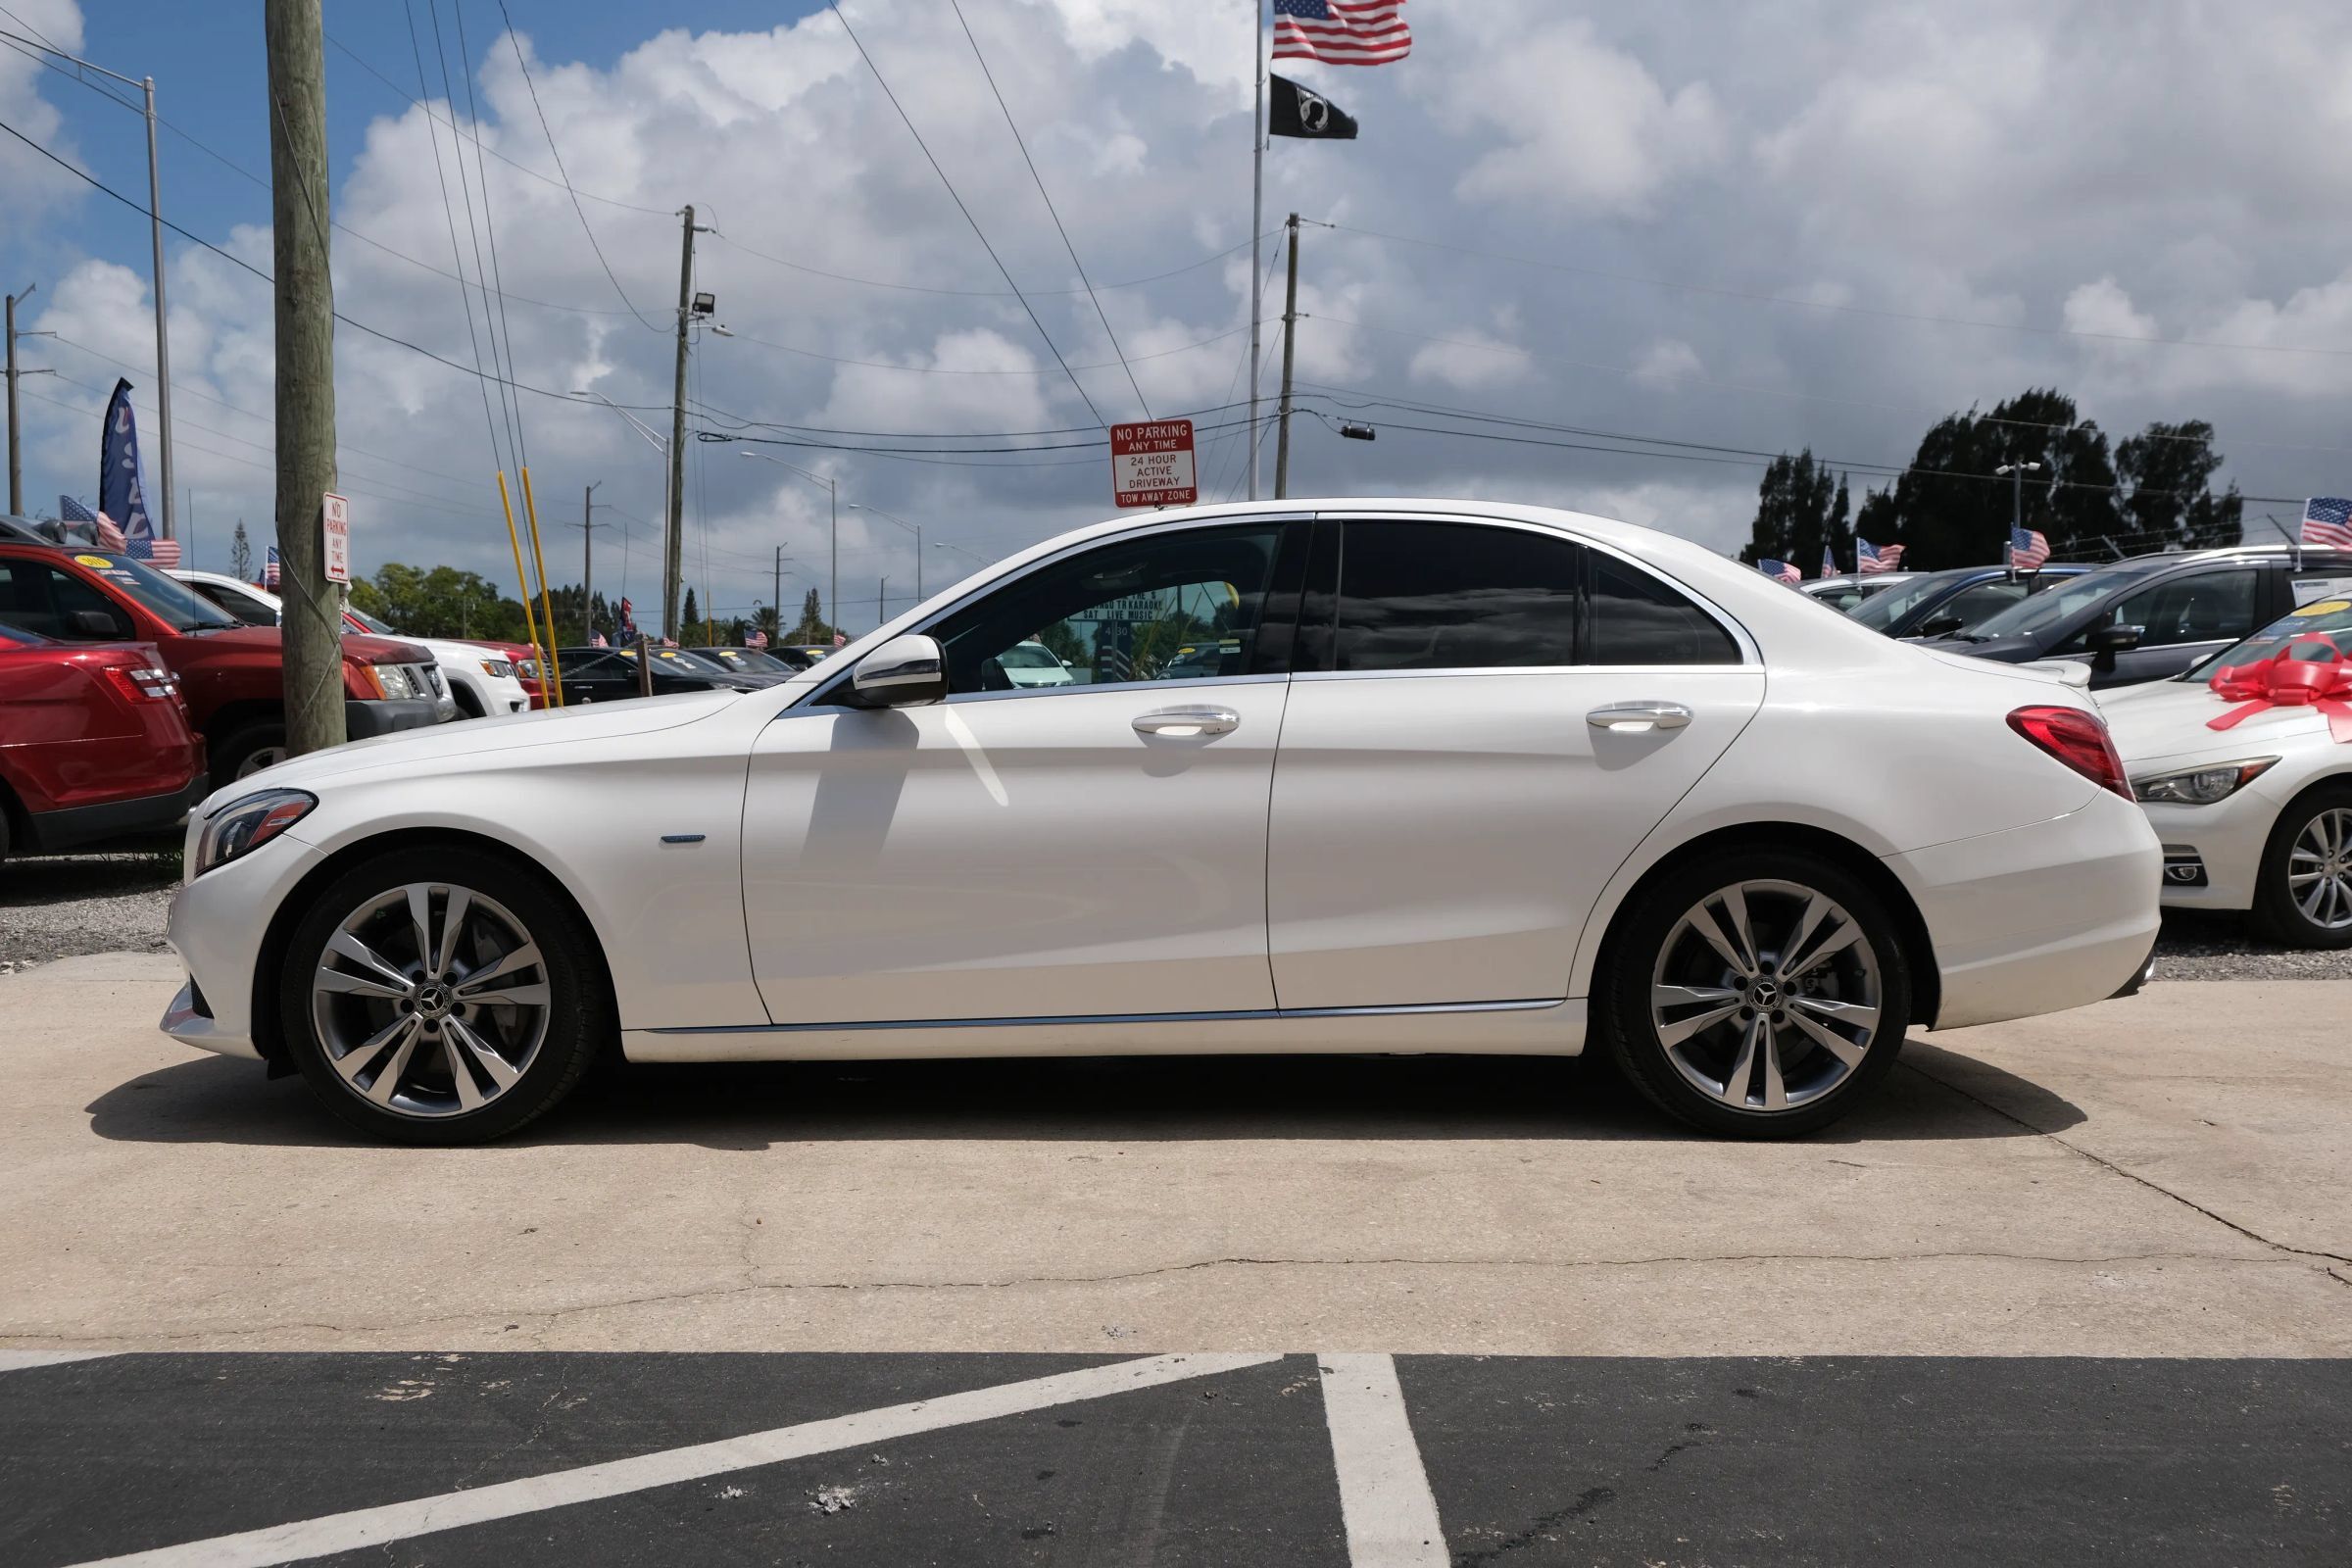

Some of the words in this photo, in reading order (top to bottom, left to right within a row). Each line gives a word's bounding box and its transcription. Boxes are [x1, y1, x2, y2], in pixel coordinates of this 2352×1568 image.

[1116, 428, 1132, 441] NO
[1137, 424, 1187, 439] PARKING
[1129, 441, 1150, 452] ANY
[1153, 439, 1177, 450] TIME
[1131, 457, 1144, 466] 24
[1149, 455, 1176, 465] HOUR
[1137, 466, 1172, 476] ACTIVE
[1129, 476, 1180, 488] DRIVEWAY
[1121, 494, 1138, 503] TOW
[1142, 492, 1164, 502] AWAY
[1167, 490, 1191, 500] ZONE
[332, 501, 341, 517] NO
[326, 518, 346, 536] PARKING
[332, 538, 342, 549] ANY
[331, 550, 343, 564] TIME
[1083, 611, 1098, 619] SAT
[1107, 611, 1123, 619] LIVE
[1128, 611, 1152, 619] MUSIC
